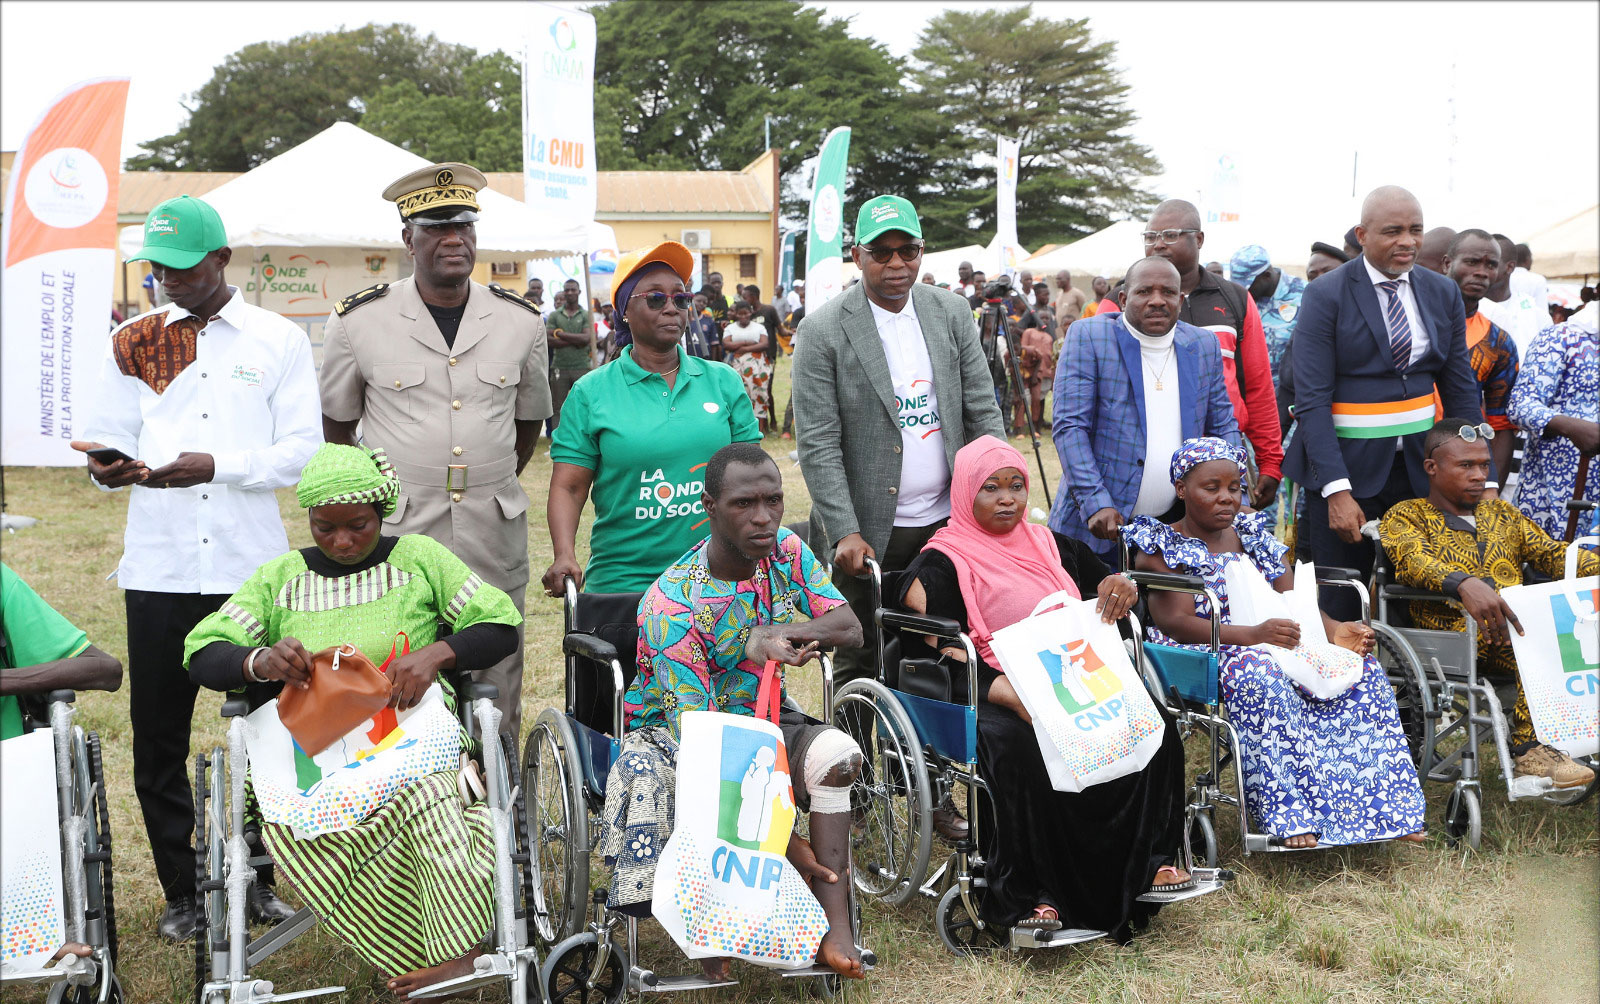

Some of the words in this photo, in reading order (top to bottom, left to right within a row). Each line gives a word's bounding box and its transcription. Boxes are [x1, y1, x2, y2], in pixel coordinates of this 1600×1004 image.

[530, 134, 545, 163] La
[549, 138, 584, 169] CMU
[41, 271, 55, 288] ET
[269, 282, 319, 293] SOCIAL
[62, 270, 75, 323] SOCIALE
[41, 292, 55, 348] L'EMPLOI
[41, 351, 54, 367] DE
[61, 326, 73, 403] PROTECTION
[38, 370, 54, 436] MINISTÈRE
[61, 406, 72, 421] LA
[61, 424, 72, 440] DE
[640, 468, 665, 483] LA
[639, 480, 706, 505] ROND
[635, 506, 662, 520] DU
[666, 500, 706, 518] SOC
[1074, 696, 1124, 731] CNP
[712, 846, 783, 892] CNP
